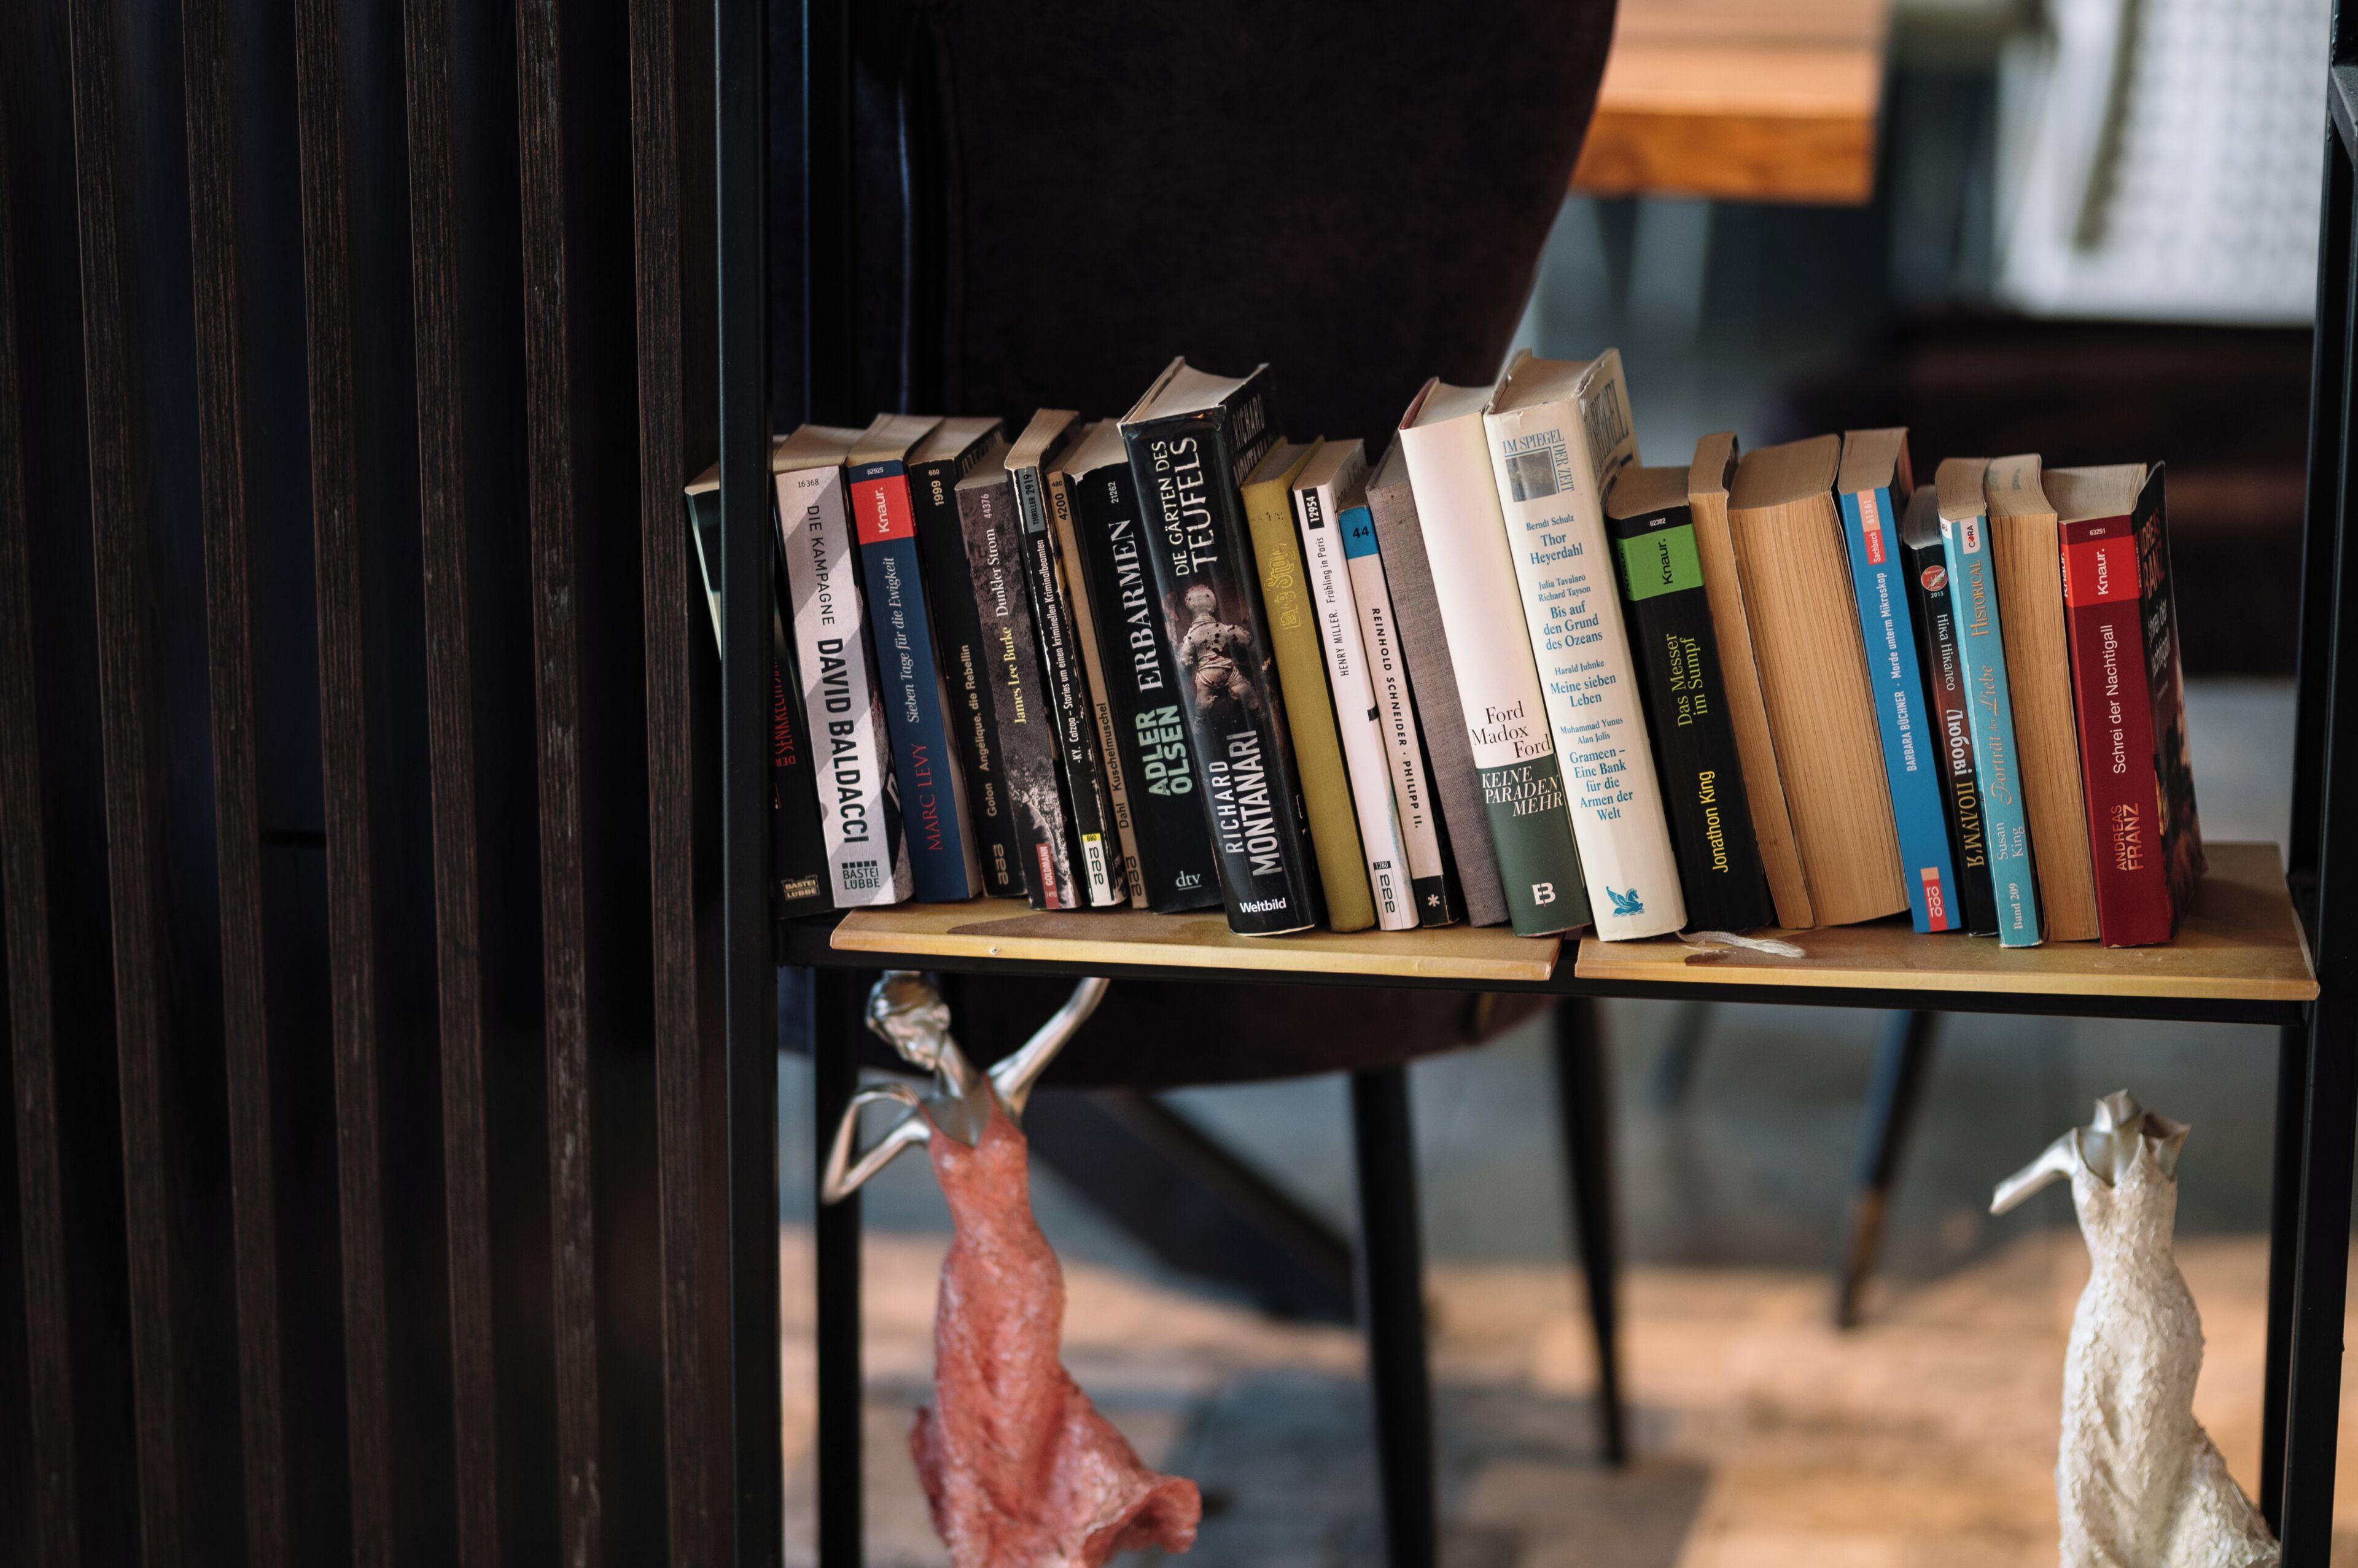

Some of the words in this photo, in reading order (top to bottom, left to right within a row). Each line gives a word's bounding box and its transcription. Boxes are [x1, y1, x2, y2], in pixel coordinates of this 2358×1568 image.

[1503, 440, 1518, 454] IM
[1519, 429, 1565, 451] SPIEGEL
[1151, 440, 1170, 472] DES
[1553, 443, 1570, 468] DER
[866, 467, 884, 475] 62925
[1023, 473, 1035, 494] 2919
[1558, 468, 1575, 492] ZEIT
[931, 480, 944, 506] 1999
[981, 493, 992, 519] 44376
[1108, 481, 1119, 504] 21262
[1169, 437, 1219, 573] TEUFELS
[807, 505, 822, 532] DIE
[875, 486, 890, 534] Knaur.
[1029, 496, 1040, 526] THRILLER
[1054, 493, 1068, 521] 4200
[1158, 477, 1184, 545] GÄRTEN
[1305, 495, 1320, 522] 12954
[1862, 499, 1875, 524] 61361
[1352, 526, 1370, 539] 44
[1526, 516, 1551, 531] Berndt
[1551, 513, 1575, 528] Schulz
[1649, 518, 1666, 527] 62382
[2089, 527, 2106, 536] 63251
[986, 528, 1000, 565] Strom
[1316, 537, 1328, 559] Paris
[1530, 543, 1584, 565] Heyerdahl
[1540, 533, 1567, 548] Thor
[1869, 531, 1881, 563] Sachbuch
[1037, 539, 1055, 604] Kriminalbeamten
[1172, 550, 1190, 576] DIE
[1320, 559, 1328, 568] in
[1658, 538, 1673, 585] Knaur.
[2097, 548, 2109, 596] Knaur.
[811, 537, 835, 626] KAMPAGNE
[883, 556, 901, 608] Ewigkeit
[990, 566, 1009, 617] Dunkler
[1322, 570, 1336, 604] Frühling
[1538, 580, 1555, 591] Julia
[1556, 573, 1586, 587] Tavalaro
[1538, 589, 1566, 602] Richard
[1567, 584, 1592, 598] Tayson
[1876, 572, 1891, 618] Mikroskop
[892, 610, 905, 629] die
[1108, 519, 1164, 693] ERBARMEN
[1550, 605, 1567, 619] Bis
[1570, 600, 1587, 615] auf
[1047, 604, 1063, 646] kriminellen
[1329, 609, 1344, 643] MILLER.
[1543, 623, 1562, 635] den
[1565, 613, 1600, 632] Grund
[1884, 618, 1897, 650] unterm
[895, 631, 911, 651] für
[1000, 627, 1016, 662] Burke
[1546, 638, 1563, 651] des
[1565, 631, 1603, 648] Ozeans
[900, 653, 914, 681] Tage
[960, 644, 976, 690] Rebellin
[1056, 647, 1066, 668] einen
[1336, 648, 1350, 677] HENRY
[1554, 664, 1579, 676] Harald
[1580, 659, 1605, 673] Juhnke
[1666, 633, 1687, 693] Messer
[1679, 637, 1704, 690] Sumpf
[1888, 651, 1902, 679] Morde
[2100, 624, 2119, 696] Nachtigall
[817, 638, 852, 713] DAVID
[1008, 664, 1021, 686] Lee
[1060, 669, 1068, 683] um
[1550, 681, 1582, 695] Meine
[1584, 674, 1617, 691] sieben
[905, 683, 920, 724] Sieben
[968, 693, 979, 710] die
[1061, 683, 1073, 710] Stories
[1570, 692, 1602, 708] Leben
[1693, 693, 1708, 716] im
[1979, 664, 2000, 718] Liebe
[1014, 688, 1027, 724] James
[1372, 608, 1392, 671] REINHOLD
[1387, 677, 1407, 746] SCHNEIDER
[1403, 761, 1419, 809] PHILIPP
[1485, 700, 1525, 724] Ford
[1677, 695, 1693, 728] Das
[1894, 690, 1911, 731] BÜCHNER
[2108, 700, 2122, 724] der
[1471, 724, 1530, 746] Madox
[1560, 721, 1600, 735] Muhammad
[1601, 716, 1624, 729] Yunus
[1577, 734, 1594, 745] Alan
[1595, 731, 1611, 743] Jolis
[1989, 718, 1998, 732] der
[1097, 702, 1123, 791] Kuschelmuschel
[1135, 709, 1171, 796] ADLER
[1156, 705, 1193, 794] OLSEN
[1513, 733, 1552, 759] Ford
[1901, 732, 1918, 772] BARBARA
[1946, 708, 1973, 776] Любові
[2109, 728, 2126, 774] Schrei
[911, 743, 933, 788] LEVY
[1570, 749, 1617, 765] Grameen
[1574, 766, 1597, 779] Eine
[1599, 759, 1627, 776] Bank
[828, 720, 870, 844] BALDACCI
[1481, 766, 1533, 789] KEINE
[1586, 780, 1601, 793] für
[1604, 776, 1621, 790] die
[1989, 736, 2013, 807] Porträt
[985, 782, 997, 817] Golon
[1485, 774, 1560, 804] PARADEN
[1580, 793, 1614, 809] Armen
[1616, 790, 1633, 802] der
[1698, 770, 1716, 805] King
[1116, 802, 1129, 829] Dahl
[1208, 761, 1245, 853] RICHARD
[1226, 729, 1283, 877] MONTANARI
[1512, 791, 1564, 817] MEHR
[1597, 807, 1622, 821] Welt
[920, 794, 943, 851] MARC
[1705, 806, 1729, 873] Jonathon
[1996, 821, 2009, 861] Susan
[2012, 826, 2025, 858] King
[2110, 804, 2128, 871] ANDREAS
[2122, 802, 2144, 871] FRANZ
[842, 867, 879, 880] BASTEI
[1040, 846, 1054, 887] GOLDMANN
[1175, 870, 1202, 888] dtv
[784, 879, 817, 890] BASTEI
[844, 877, 880, 890] LÜBBE
[2009, 882, 2019, 901] 209
[1239, 897, 1287, 914] Weltbild
[2010, 904, 2023, 930] Band
